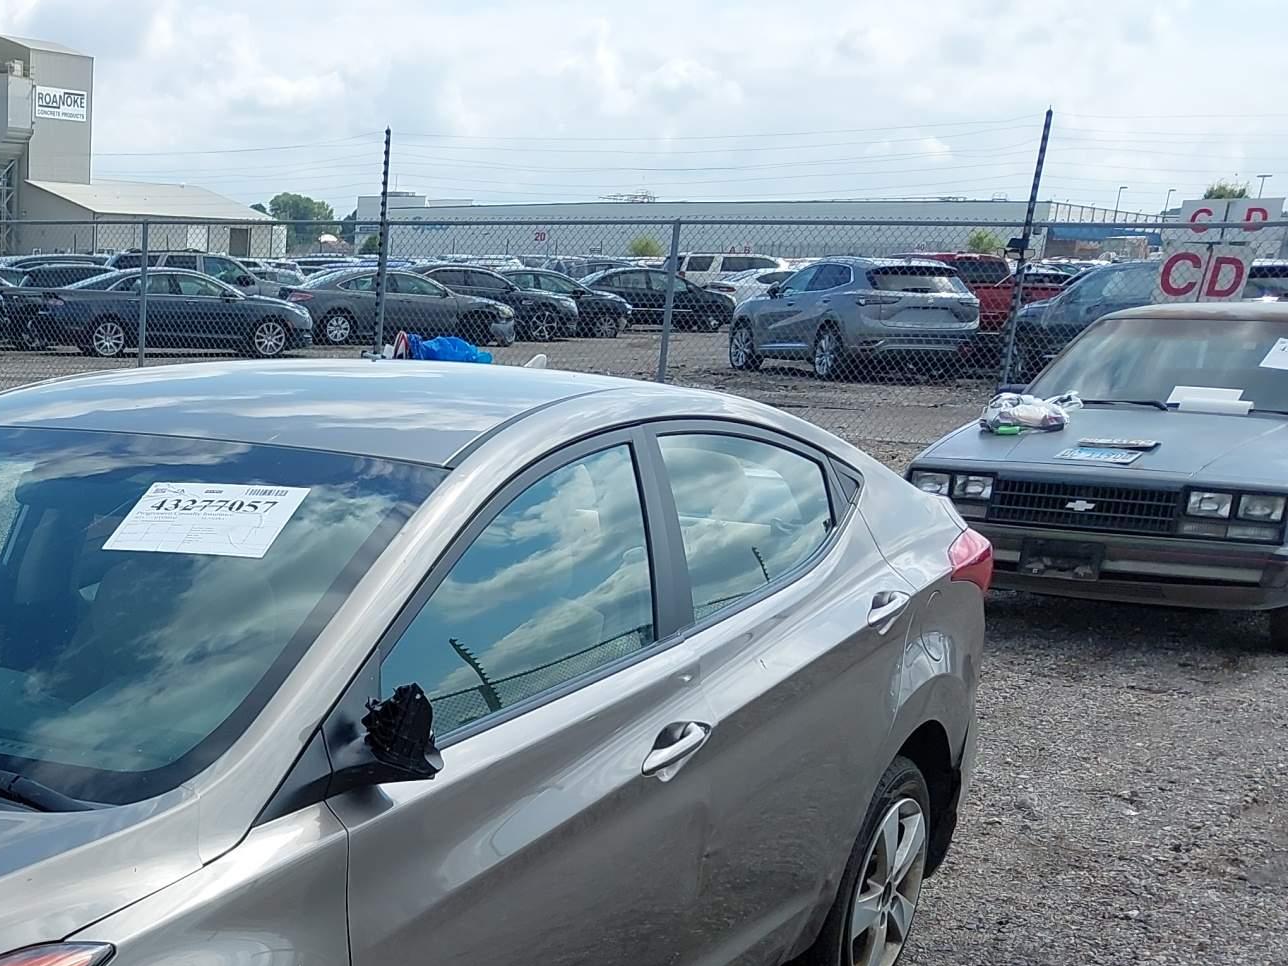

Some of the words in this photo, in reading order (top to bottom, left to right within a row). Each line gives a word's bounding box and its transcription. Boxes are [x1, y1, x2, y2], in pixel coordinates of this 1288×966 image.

[38, 92, 85, 108] ROANOKE
[1190, 208, 1214, 234] C
[534, 232, 547, 241] 20
[151, 498, 279, 514] 43277057
